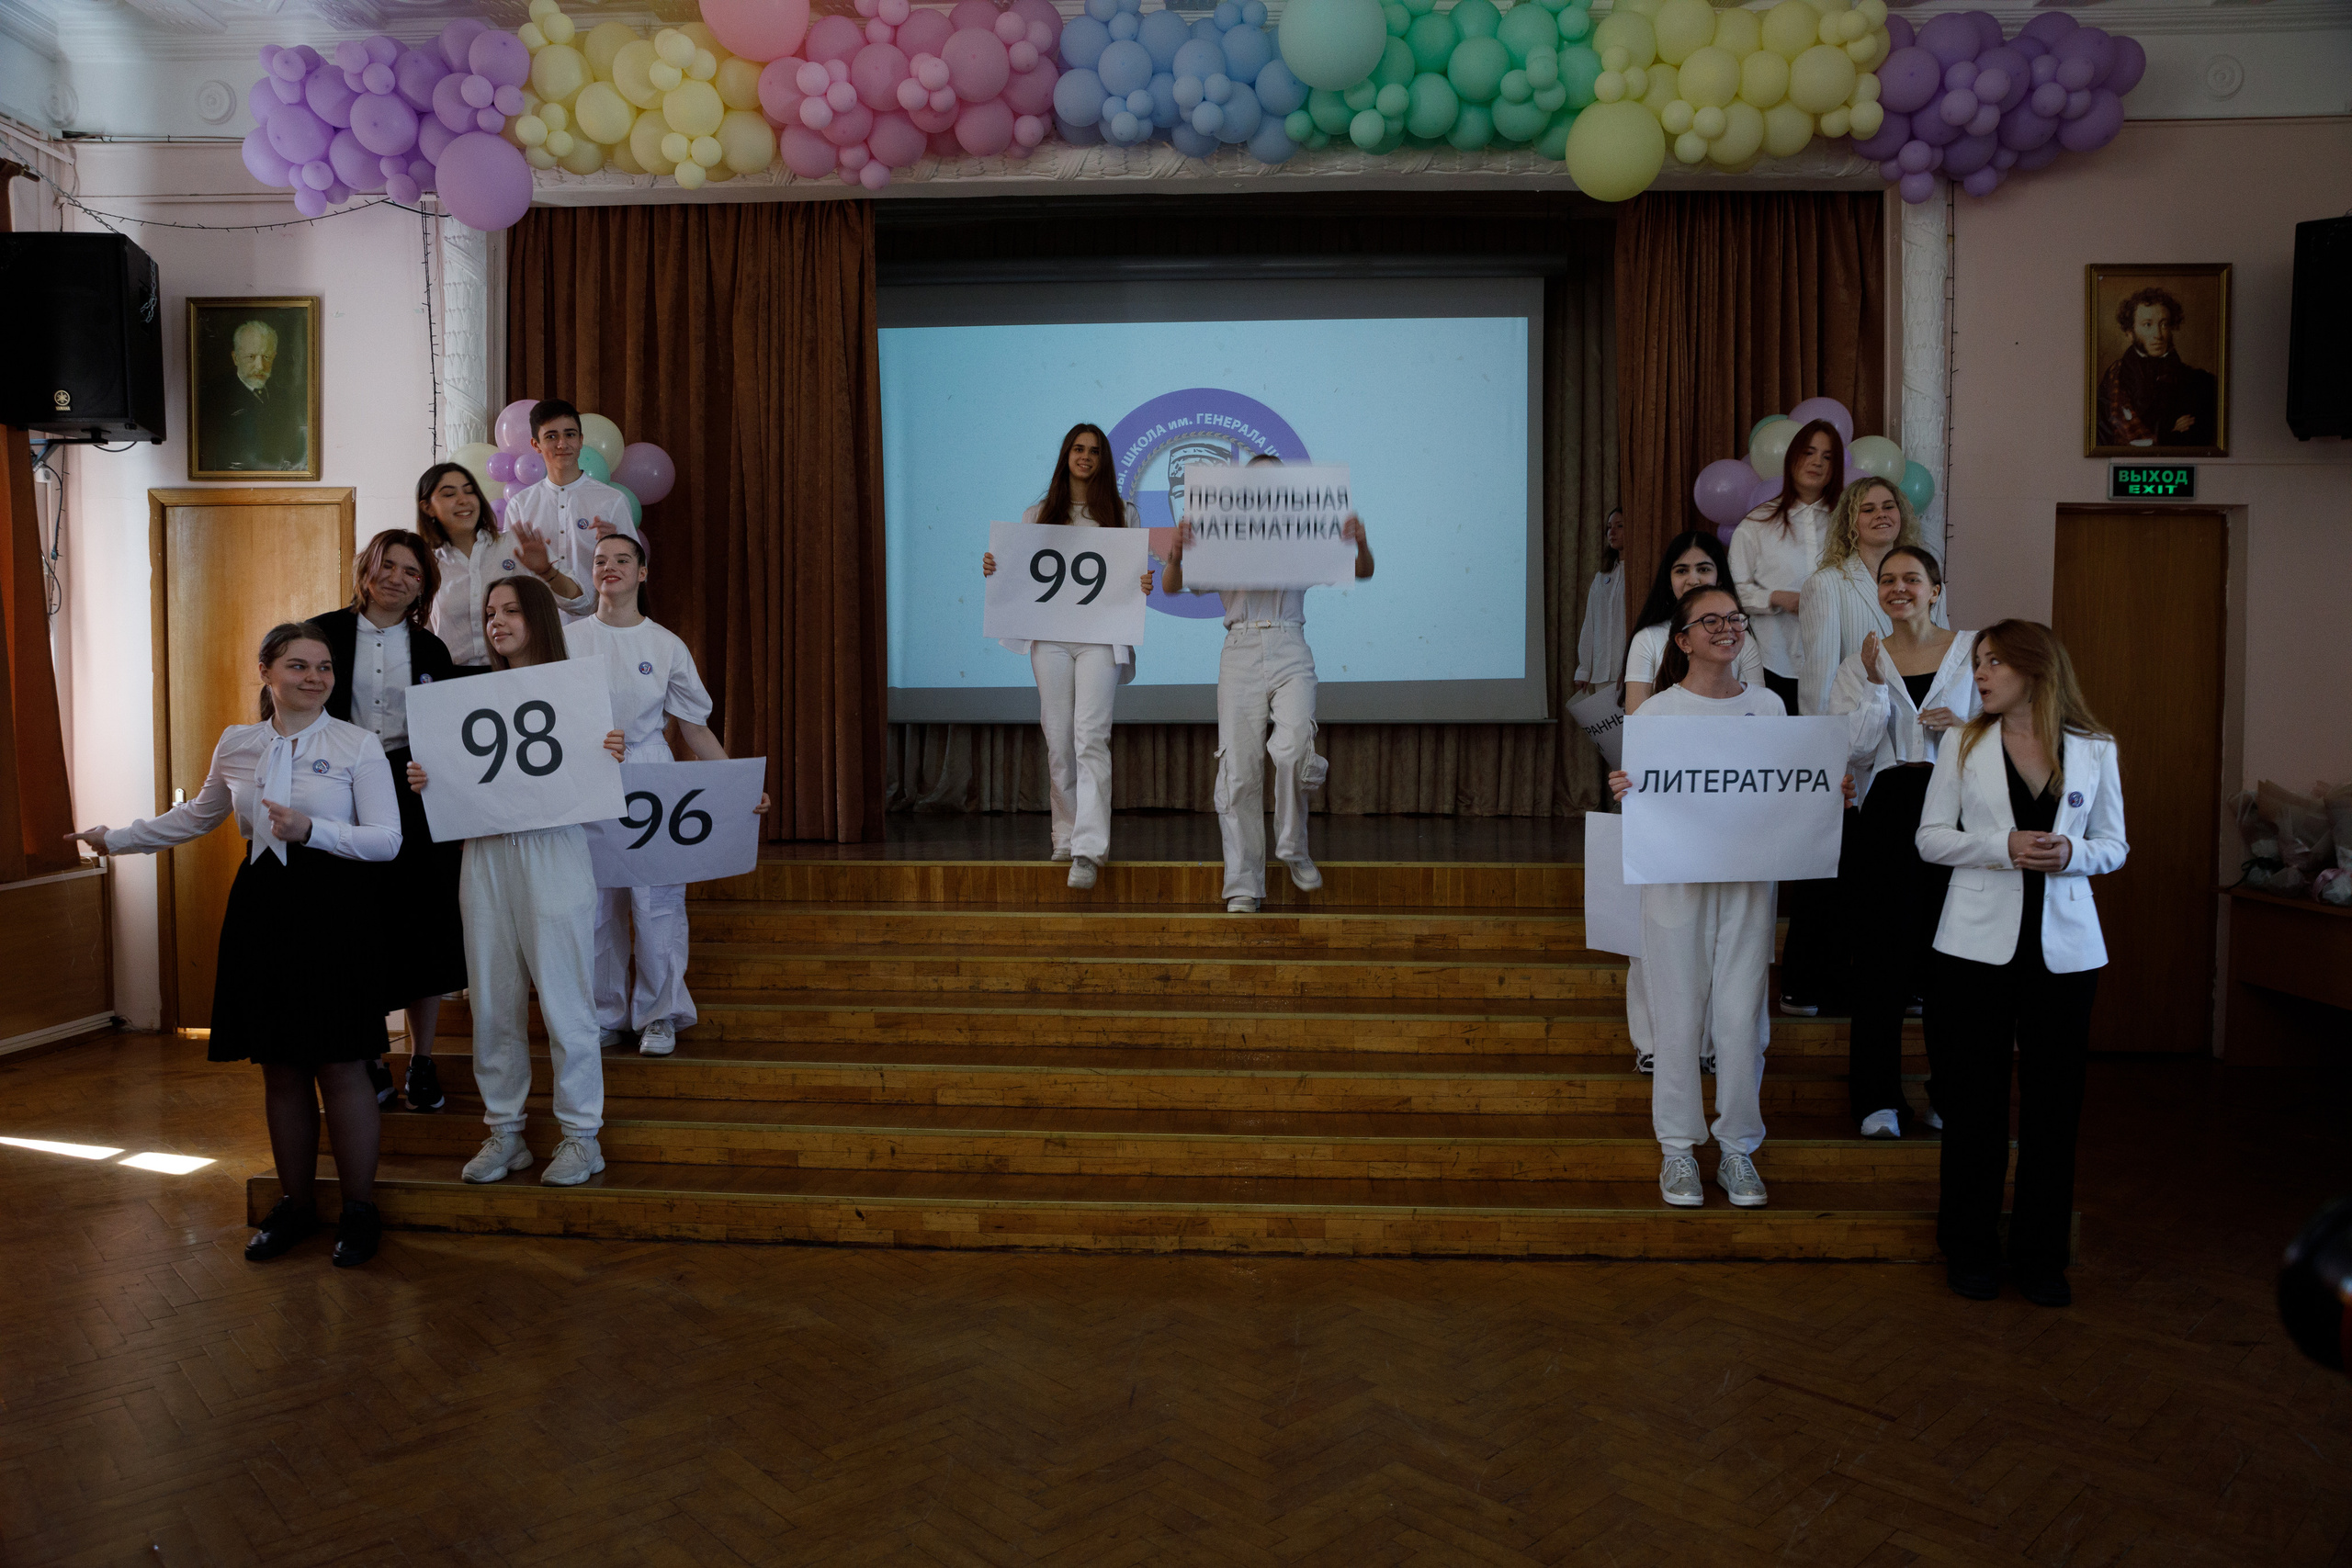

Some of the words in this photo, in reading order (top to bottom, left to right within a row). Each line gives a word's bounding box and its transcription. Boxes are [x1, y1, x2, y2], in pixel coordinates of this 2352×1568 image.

[1121, 423, 1167, 468] ШКОЛА
[1168, 417, 1193, 431] им.
[1196, 412, 1267, 448] ГЕНЕРАЛА
[2119, 469, 2188, 485] ВЫХОД
[2129, 484, 2177, 494] EXIT
[1189, 486, 1349, 512] ПРОФИЛЬНАЯ
[1189, 514, 1342, 540] МАТЕМАТИКА
[1029, 548, 1107, 605] 99
[461, 700, 562, 784] 98
[1638, 769, 1831, 793] ЛИТЕРАТУРА
[618, 788, 712, 850] 96
